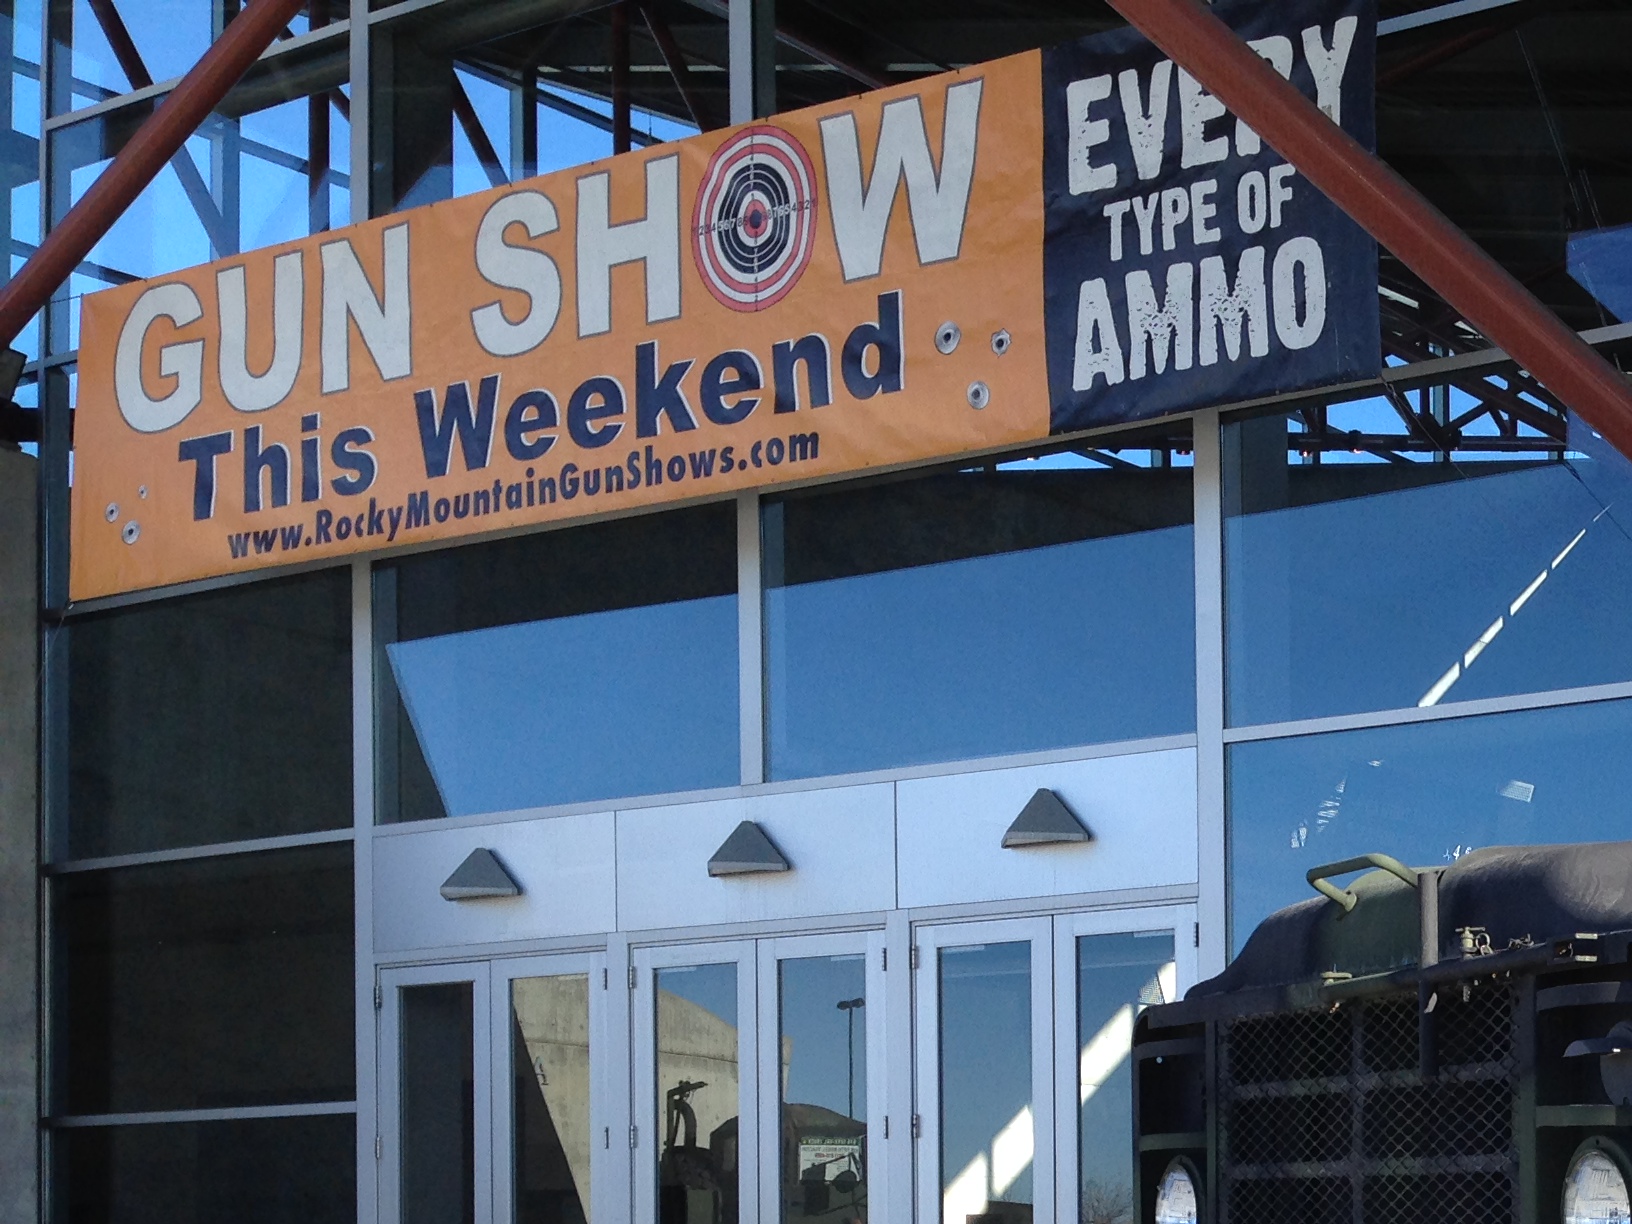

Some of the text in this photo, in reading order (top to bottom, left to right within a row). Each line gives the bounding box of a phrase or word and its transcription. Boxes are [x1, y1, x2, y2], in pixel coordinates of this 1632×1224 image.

[114, 76, 985, 433] GUN SHOW
[1102, 163, 1296, 261] TYPE OF
[1071, 236, 1327, 393] AMMO
[178, 288, 905, 521] This Weekend
[227, 429, 820, 560] www.RockyMountainGunShows.com
